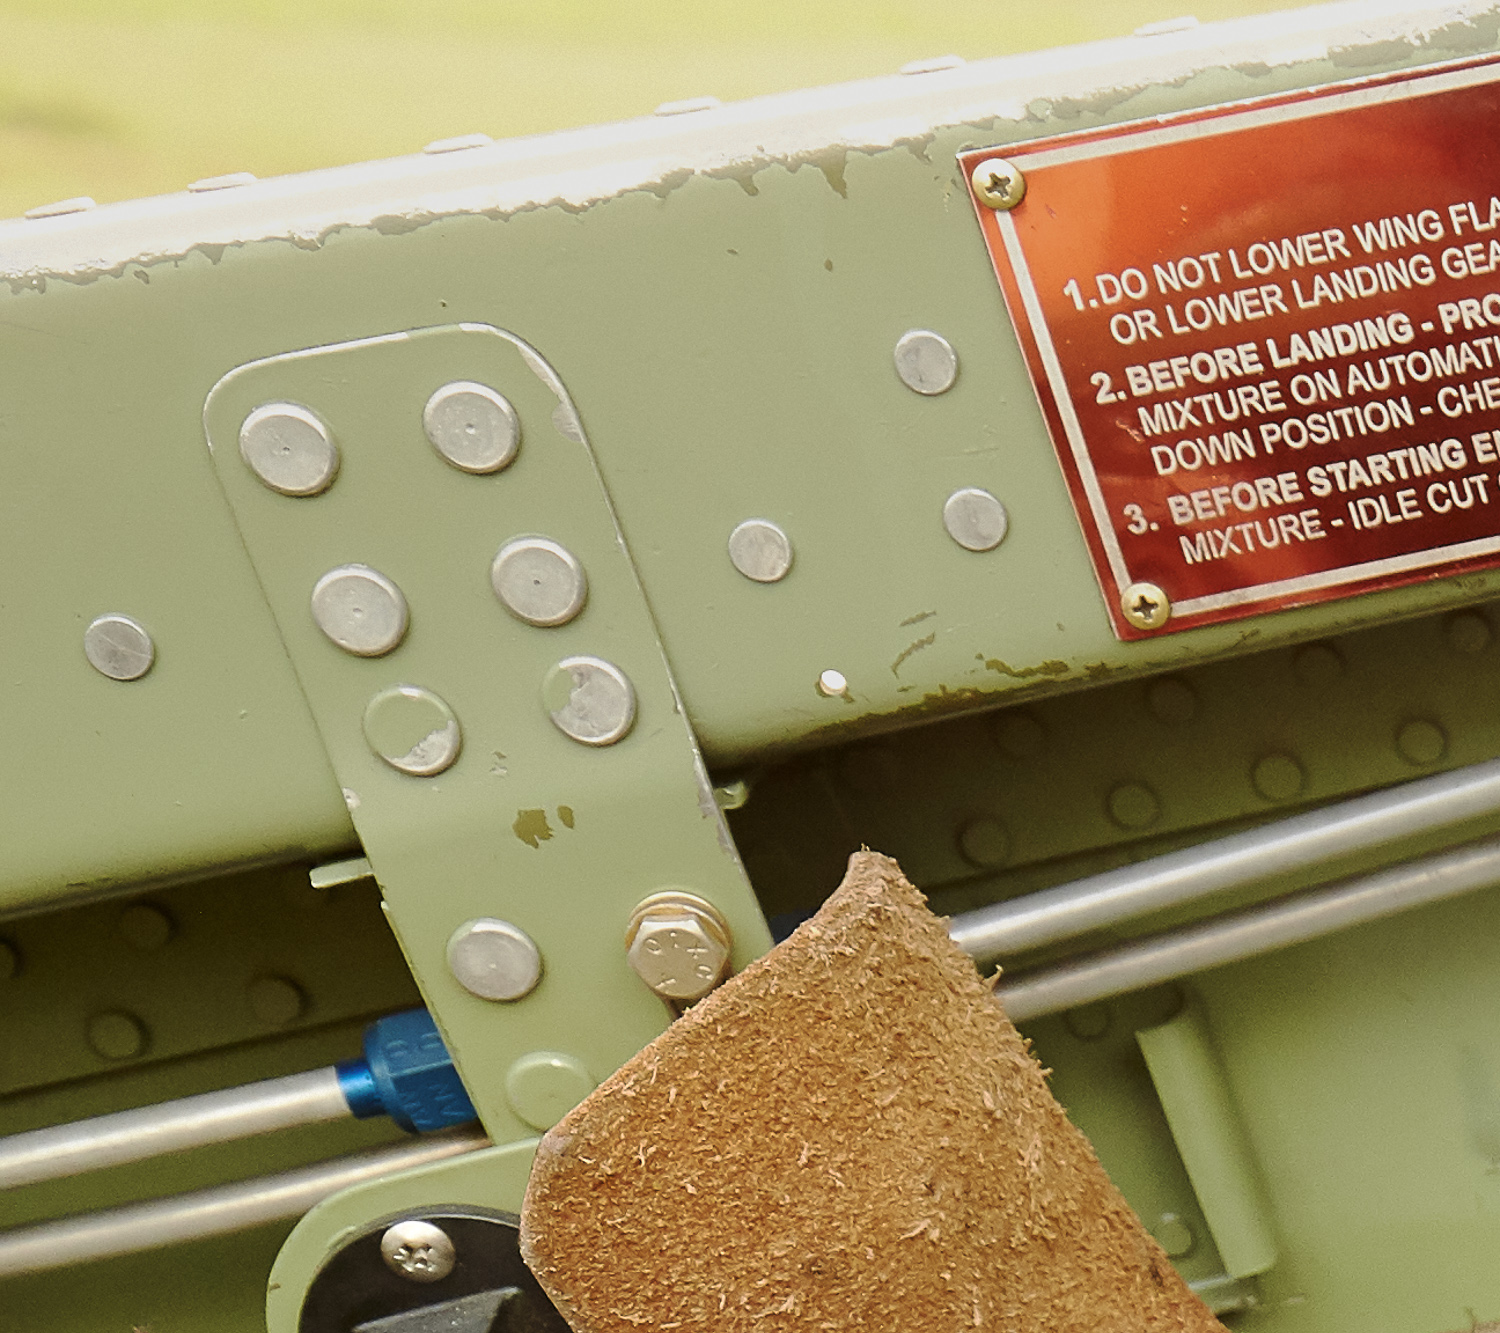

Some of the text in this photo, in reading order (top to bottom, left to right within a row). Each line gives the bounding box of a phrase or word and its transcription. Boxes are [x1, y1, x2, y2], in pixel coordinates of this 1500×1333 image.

[1151, 250, 1222, 295] NOT
[1227, 227, 1352, 279] LOWER
[1351, 208, 1445, 254] WING
[1109, 308, 1164, 346] OR
[1164, 282, 1289, 335] LOWER
[1290, 253, 1437, 310] LANDING
[1264, 311, 1415, 369] LANDING
[1136, 379, 1288, 437] MIXTURE
[1289, 367, 1343, 406] ON
[1149, 427, 1257, 476] DOWN
[1258, 394, 1415, 455] POSITION
[1122, 502, 1160, 535] 3.
[1165, 470, 1305, 526] BEFORE
[1305, 437, 1468, 497] STARTING
[1178, 507, 1328, 565] MIXTURE
[1346, 487, 1424, 531] IDLE
[1425, 472, 1490, 514] CUT
